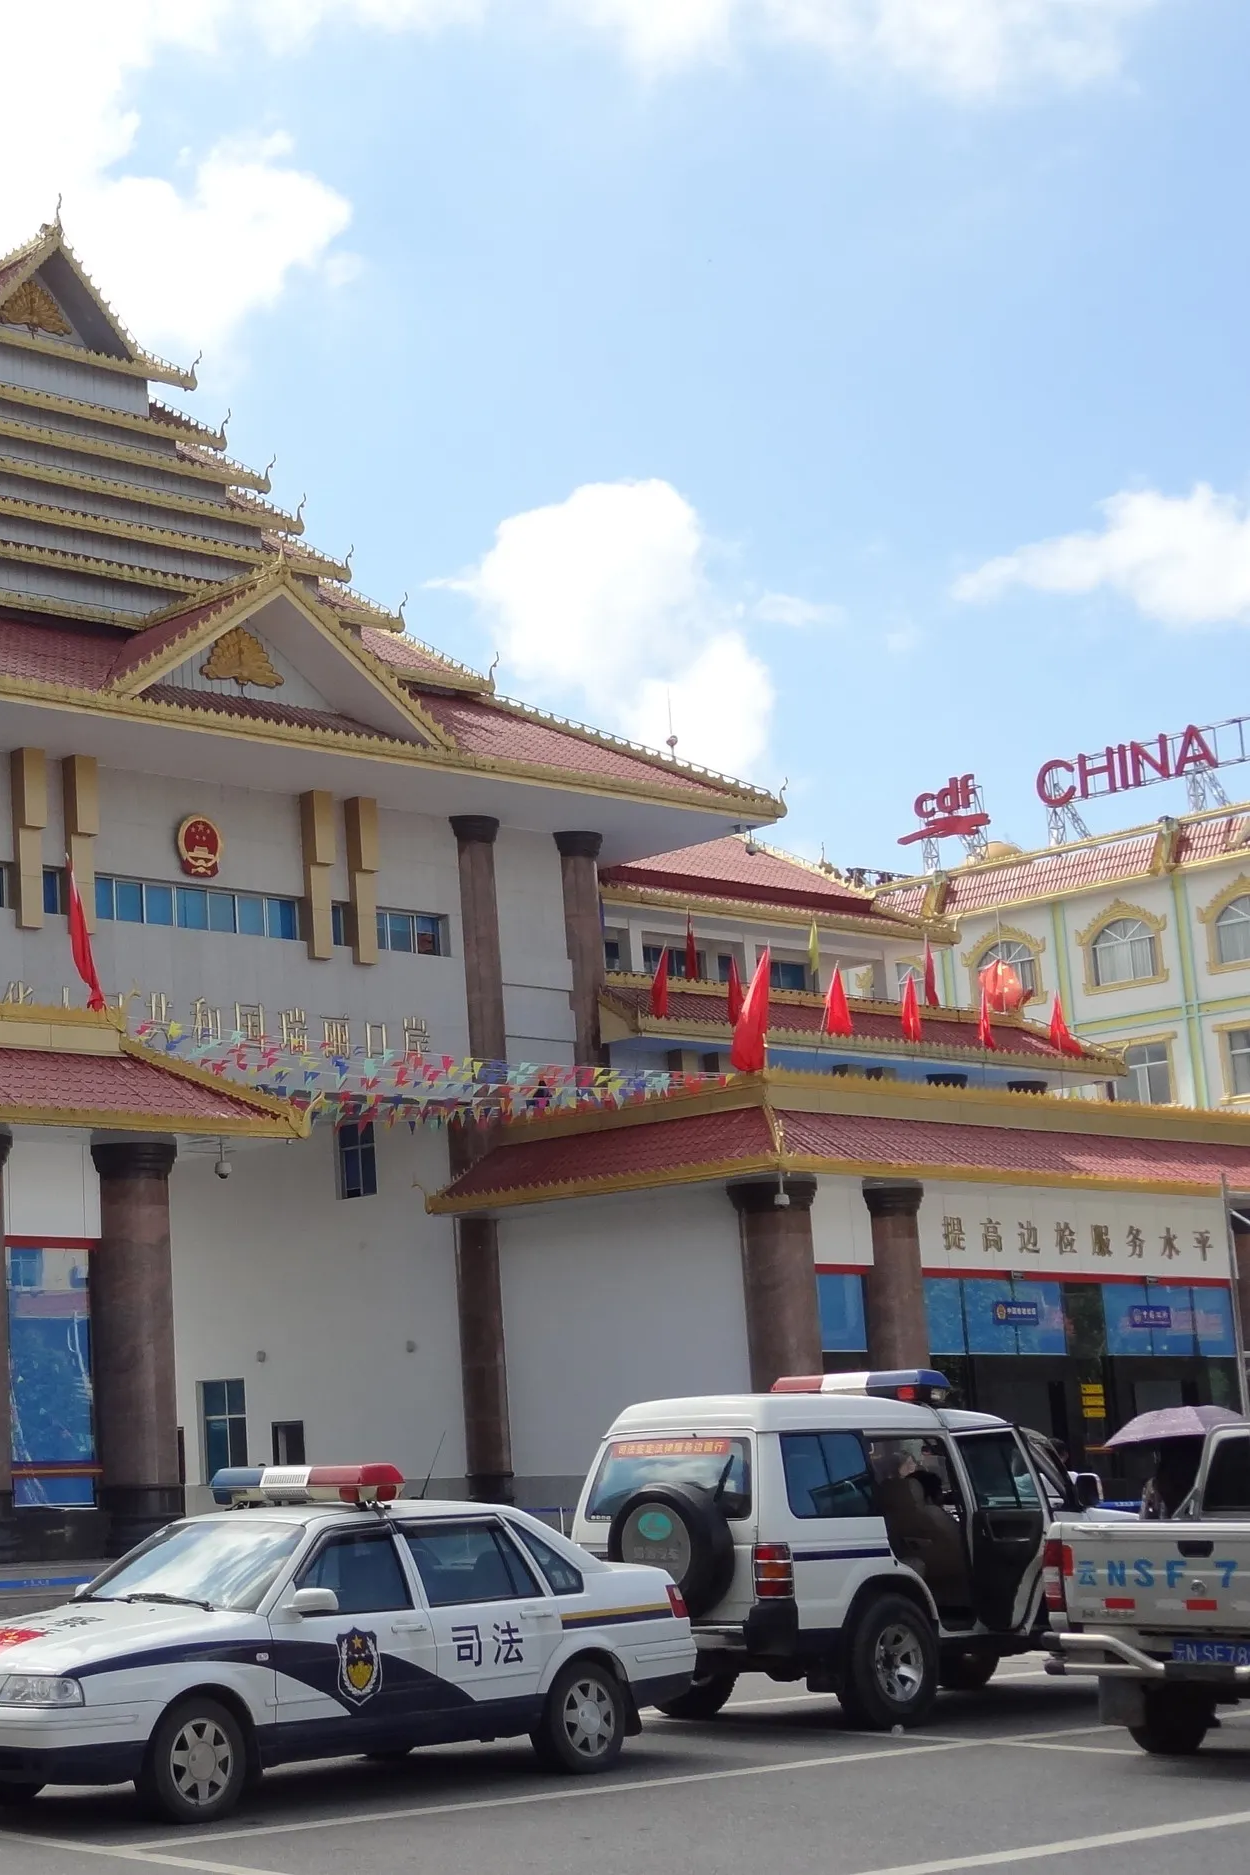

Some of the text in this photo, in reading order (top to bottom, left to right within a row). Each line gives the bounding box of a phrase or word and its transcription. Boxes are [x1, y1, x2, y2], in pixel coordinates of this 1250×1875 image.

[1036, 724, 1218, 808] CHINA
[914, 773, 975, 818] cdf
[941, 1215, 1214, 1261] 提高边检服务水平
[451, 1620, 524, 1667] 司法
